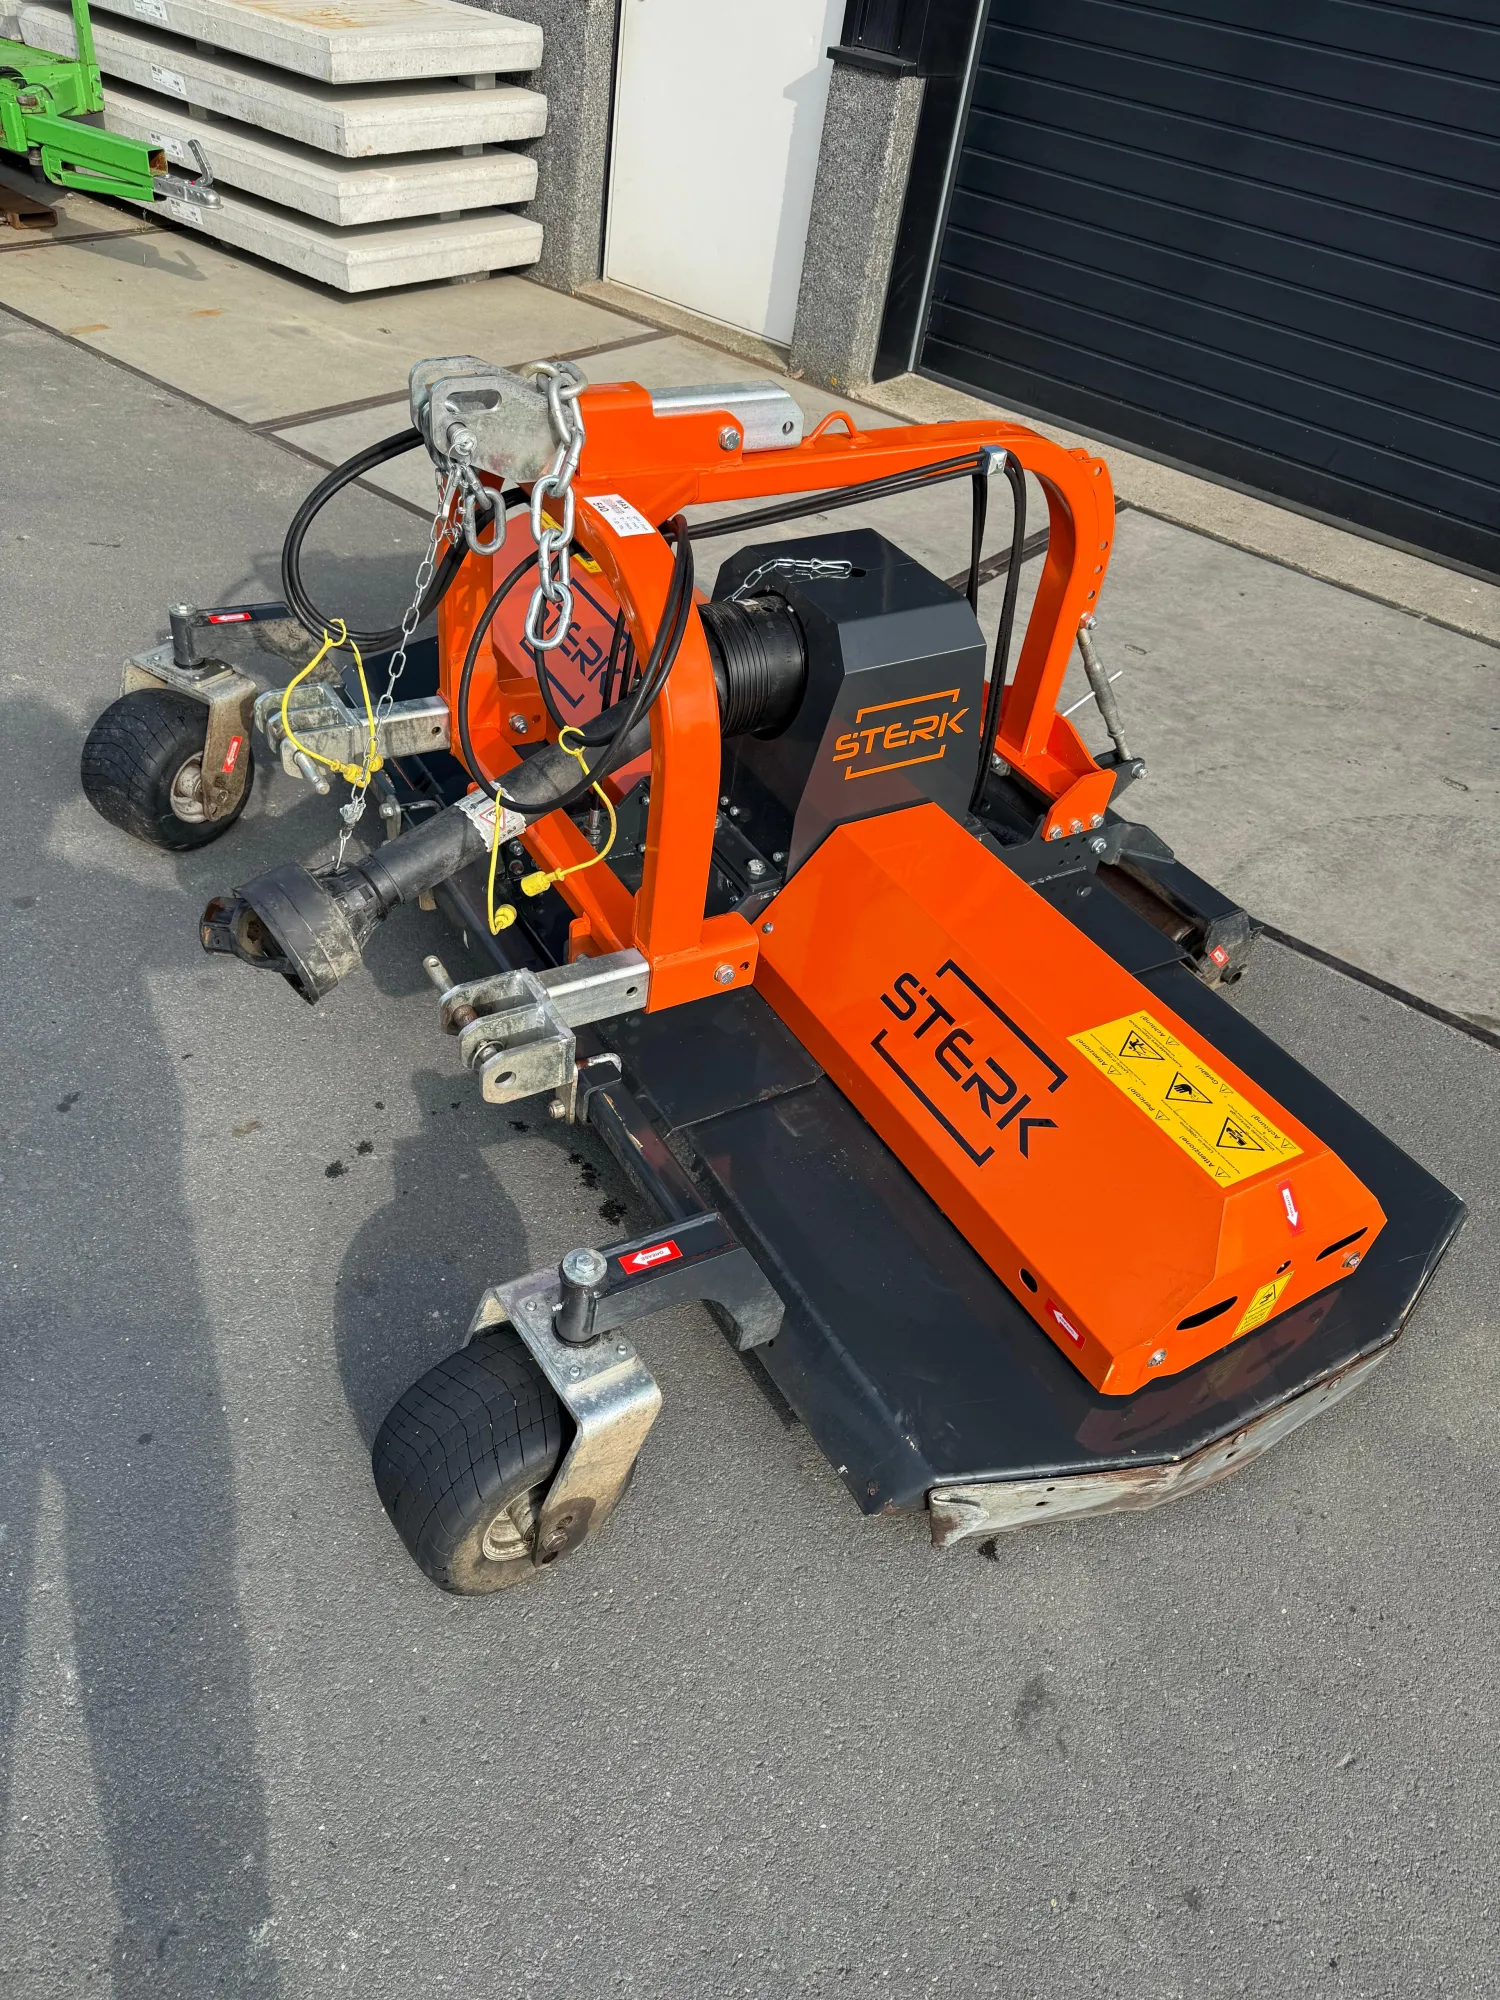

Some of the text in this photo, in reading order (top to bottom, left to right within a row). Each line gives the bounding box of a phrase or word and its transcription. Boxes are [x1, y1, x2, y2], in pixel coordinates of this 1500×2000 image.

[593, 502, 609, 513] 540
[832, 707, 969, 762] STERK
[1138, 1014, 1167, 1037] Achtung!
[1074, 1037, 1109, 1067] Attenzione!
[879, 972, 1059, 1159] STERK
[1193, 1064, 1220, 1085] Gefahr!
[1125, 1085, 1156, 1111] Pericolo!
[1248, 1113, 1282, 1140] Achtung!
[1177, 1134, 1216, 1168] Attenzione!
[639, 1250, 664, 1261] GREASE
